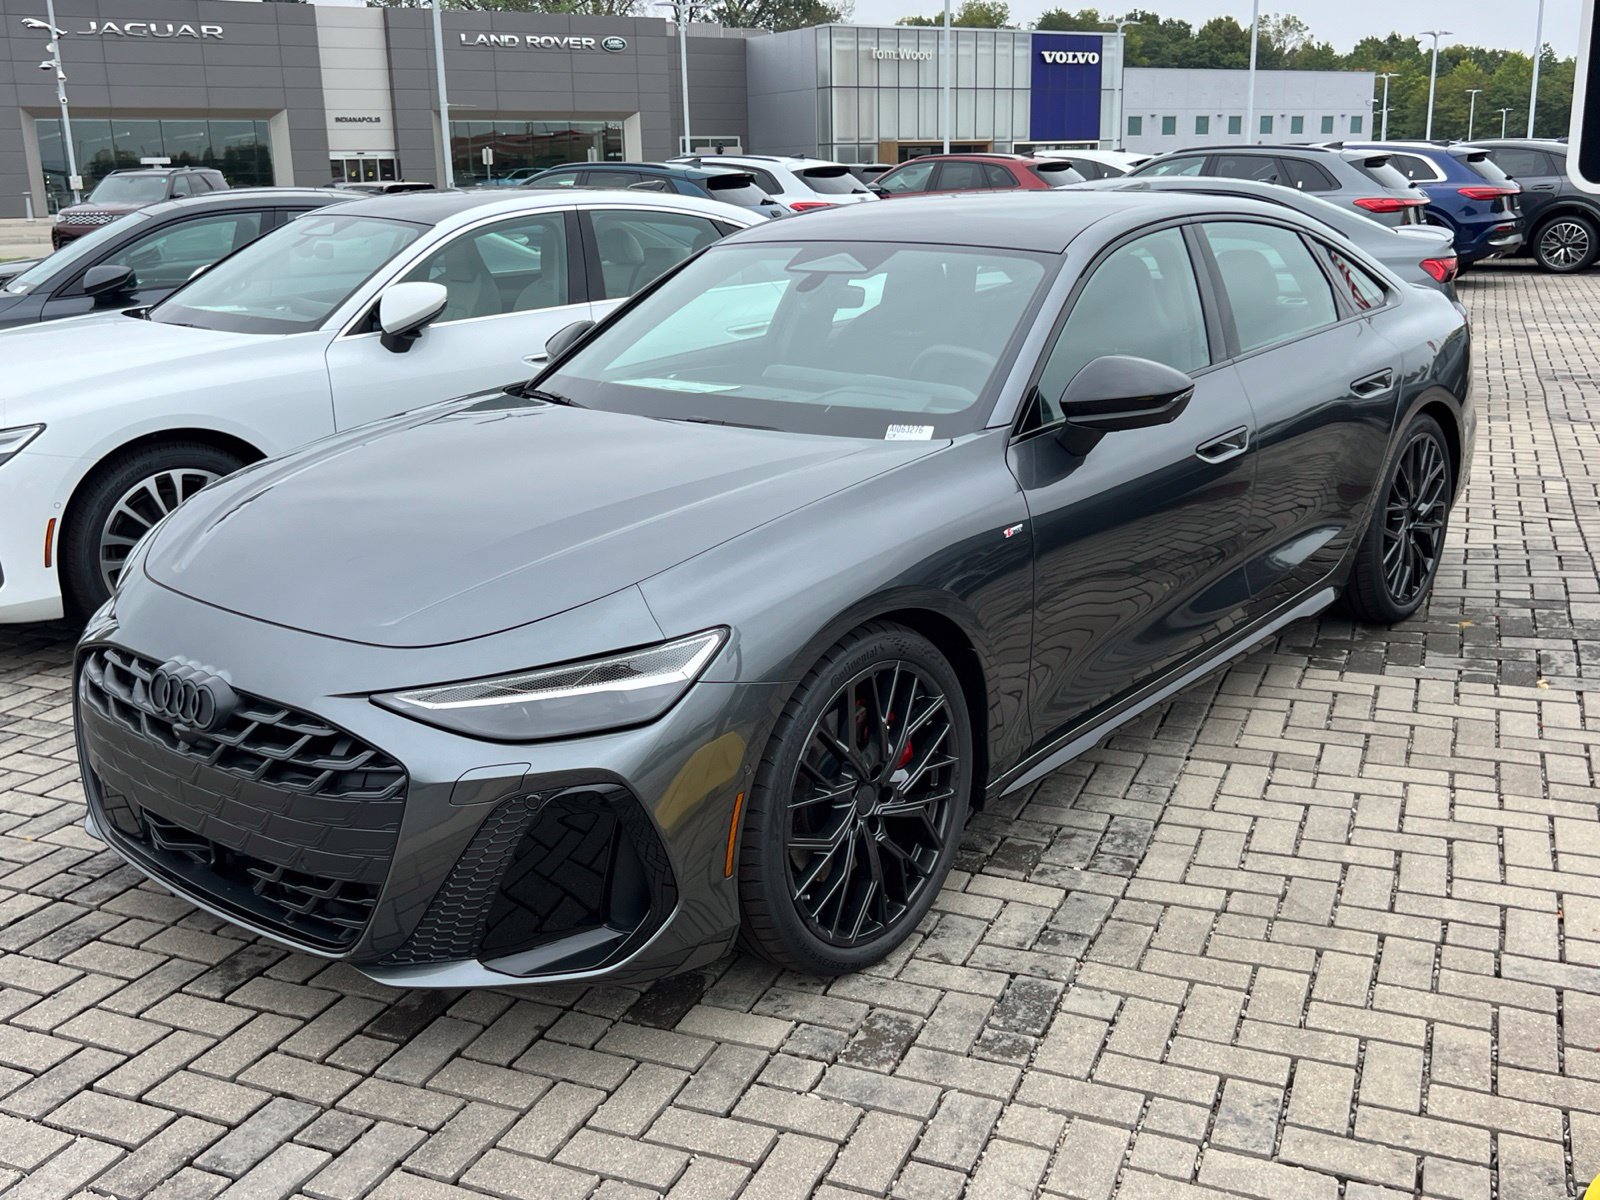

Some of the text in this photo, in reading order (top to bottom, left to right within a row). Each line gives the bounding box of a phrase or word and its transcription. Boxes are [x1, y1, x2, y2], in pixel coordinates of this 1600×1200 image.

[77, 21, 224, 39] JAGUAR
[460, 33, 596, 50] LAND ROVER
[871, 47, 932, 61] Tom Wood
[1041, 50, 1099, 65] VOLVO
